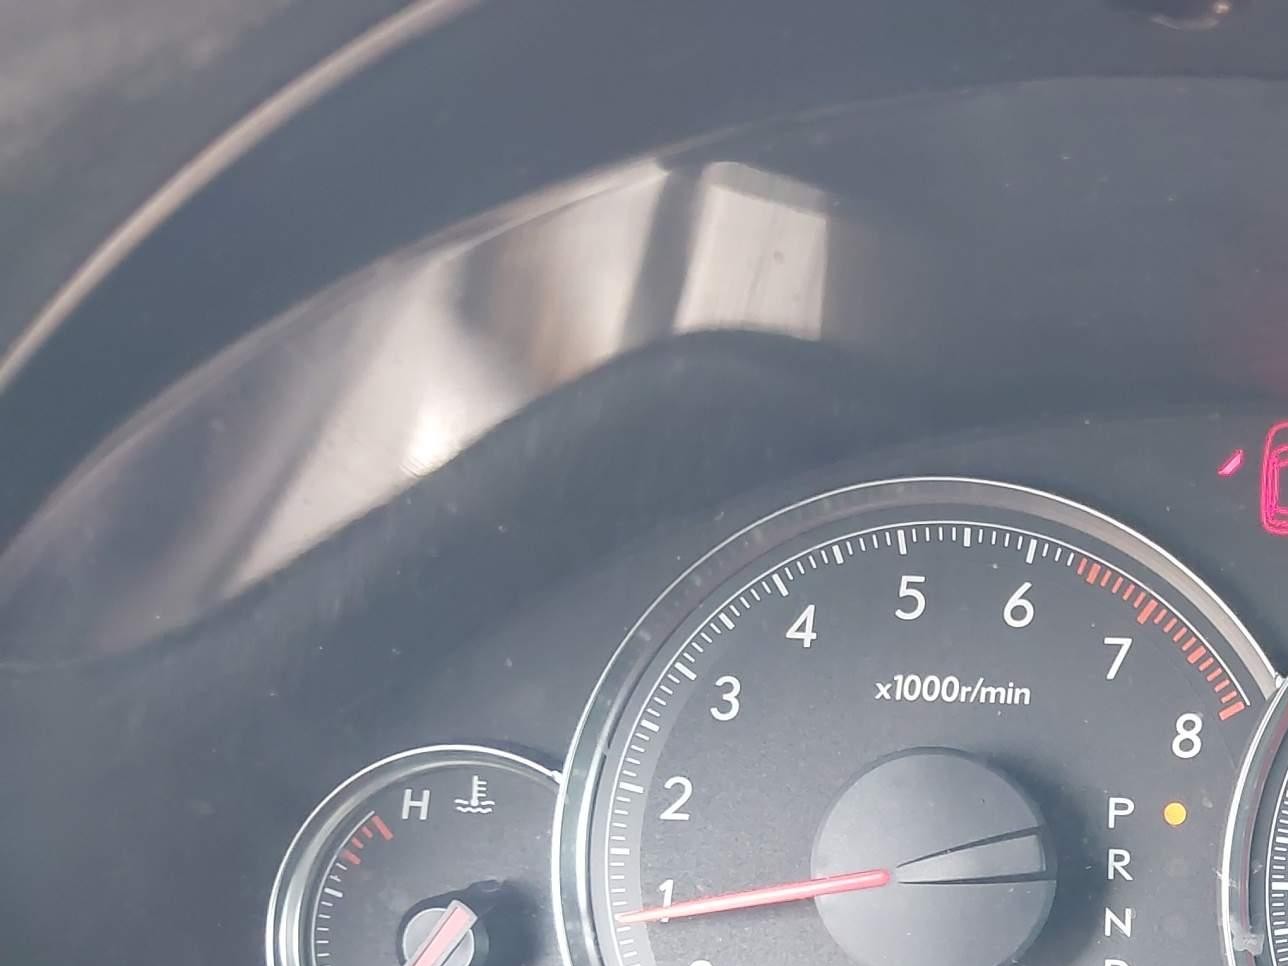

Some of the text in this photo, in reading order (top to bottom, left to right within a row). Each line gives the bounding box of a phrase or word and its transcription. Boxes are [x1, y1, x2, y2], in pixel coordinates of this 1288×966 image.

[895, 575, 926, 620] 5
[1003, 581, 1034, 628] 6
[785, 604, 817, 648] 4
[1103, 637, 1133, 680] 7
[710, 675, 741, 721] 3
[874, 674, 1031, 705] x1000r/min
[1172, 713, 1203, 759] 8
[401, 788, 430, 821] H
[659, 776, 693, 821] 2
[1108, 797, 1135, 829] P
[1108, 848, 1134, 881] R
[658, 878, 675, 923] 1
[1104, 907, 1132, 938] N
